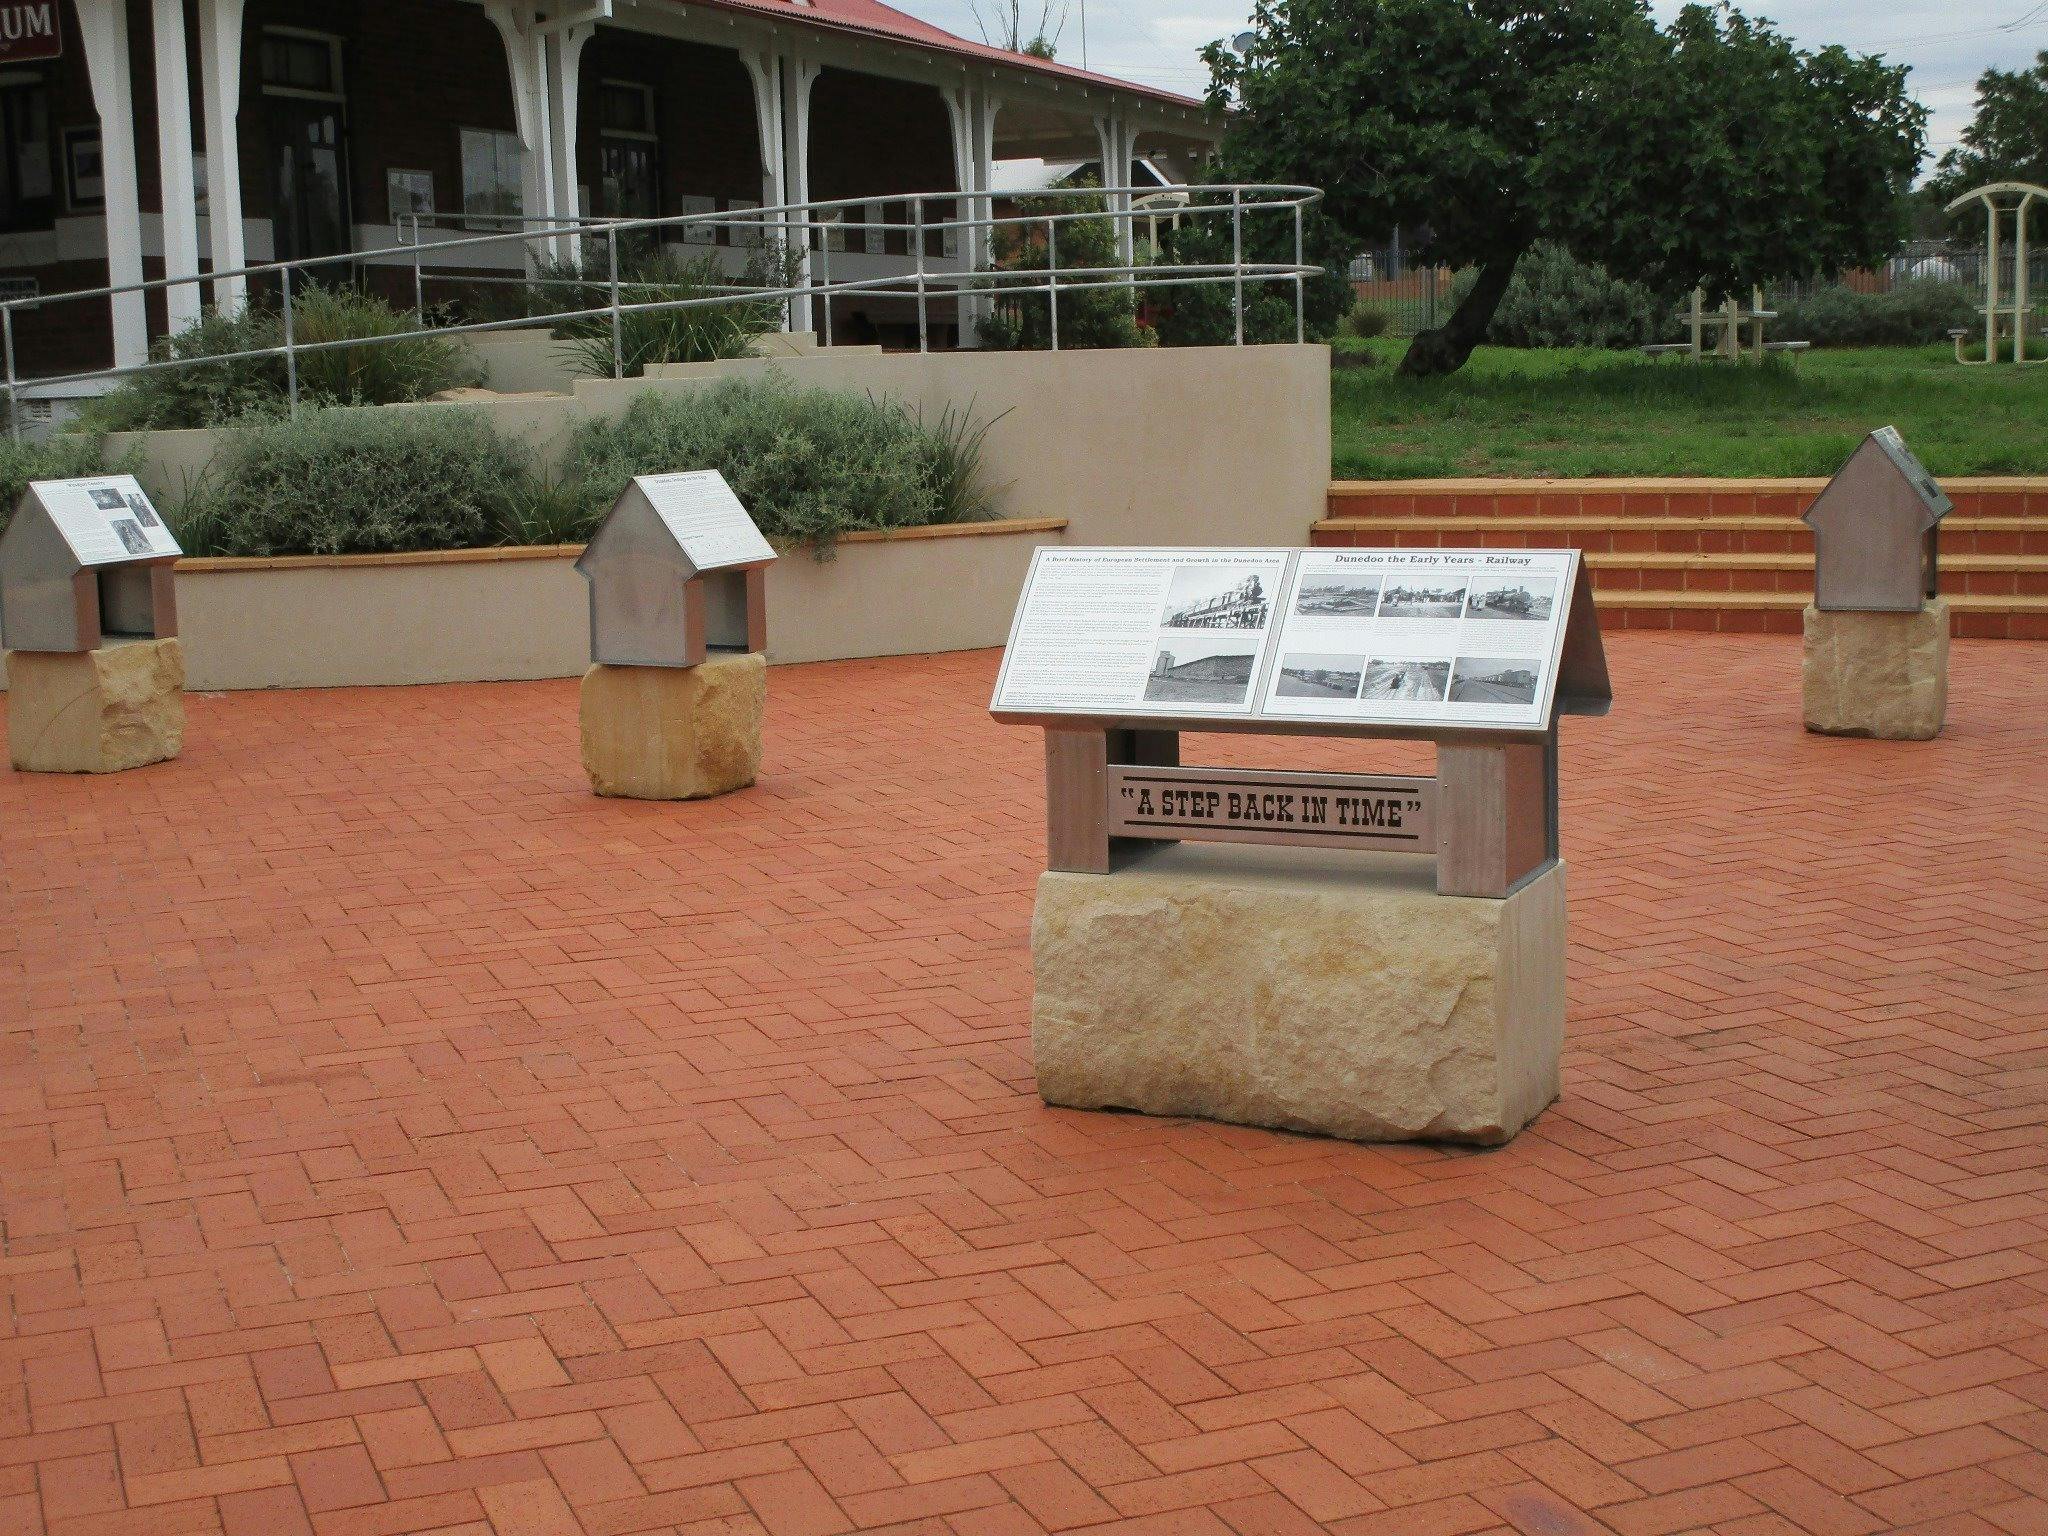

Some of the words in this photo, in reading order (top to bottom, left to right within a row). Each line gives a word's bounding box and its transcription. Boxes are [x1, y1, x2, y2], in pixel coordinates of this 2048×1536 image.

[0, 4, 54, 40] UM
[1335, 555, 1384, 563] Dunedoo
[1388, 555, 1406, 563] the
[1410, 556, 1440, 565] Early
[1444, 556, 1475, 564] Years
[1486, 556, 1532, 566] Railway
[1162, 789, 1220, 818] STEP
[1228, 793, 1294, 822] BACK
[1302, 796, 1327, 823] IN
